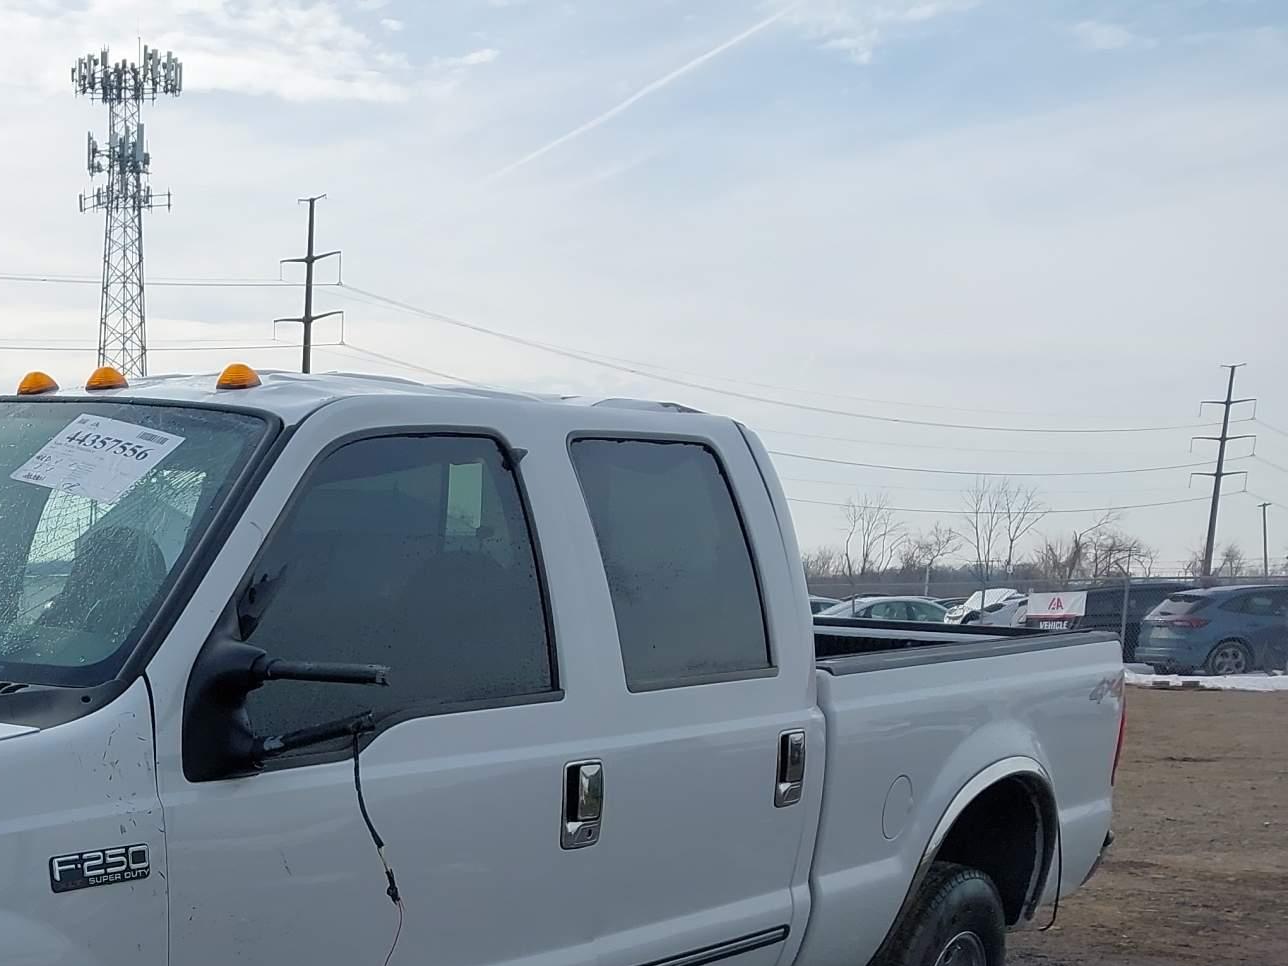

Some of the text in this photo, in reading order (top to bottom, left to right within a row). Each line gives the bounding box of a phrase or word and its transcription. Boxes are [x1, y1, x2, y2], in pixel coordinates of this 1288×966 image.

[67, 430, 154, 461] 44357556
[1039, 620, 1069, 630] VEHICLE
[88, 868, 150, 885] SUPER DUTY
